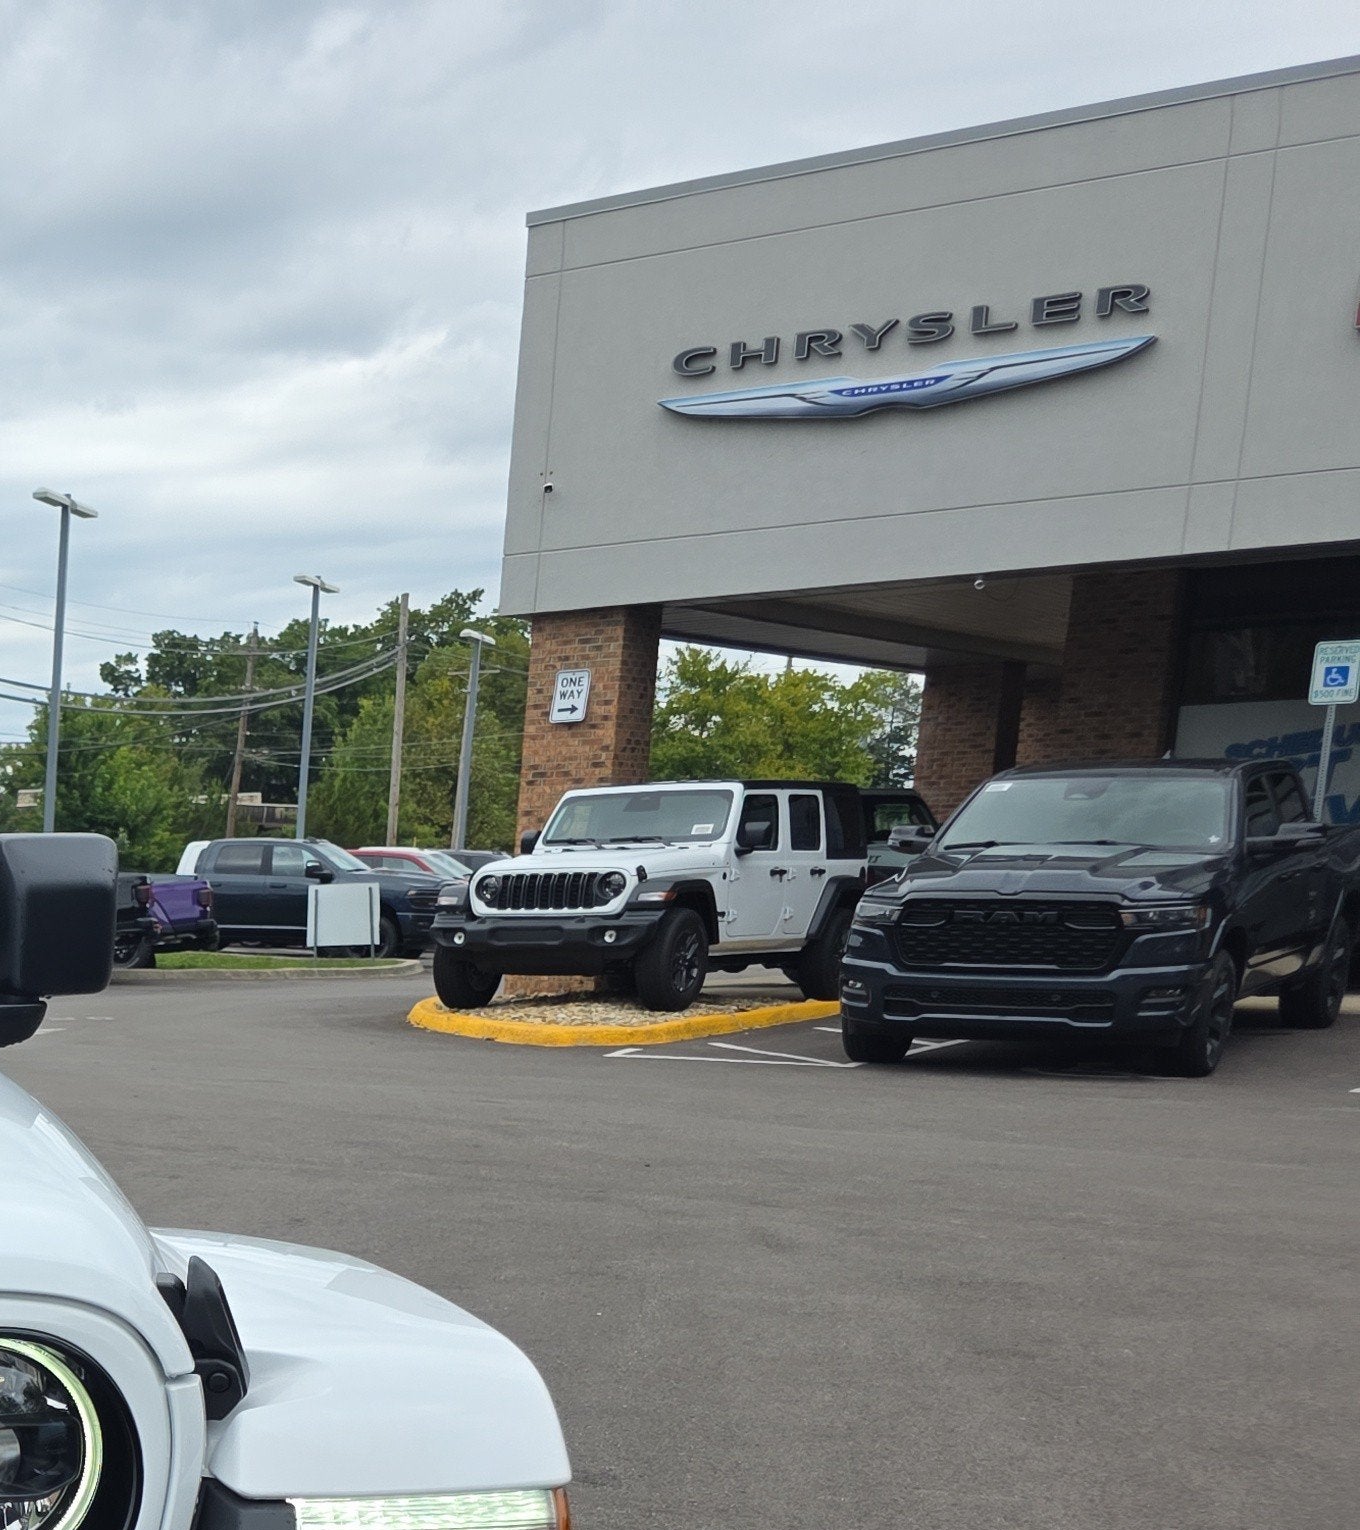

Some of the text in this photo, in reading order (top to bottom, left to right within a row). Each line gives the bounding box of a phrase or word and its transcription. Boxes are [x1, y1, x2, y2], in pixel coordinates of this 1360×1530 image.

[671, 283, 1151, 377] CHRYSLER
[841, 379, 936, 396] CHRYSLER
[560, 676, 585, 688] ONE
[559, 689, 584, 700] WAY
